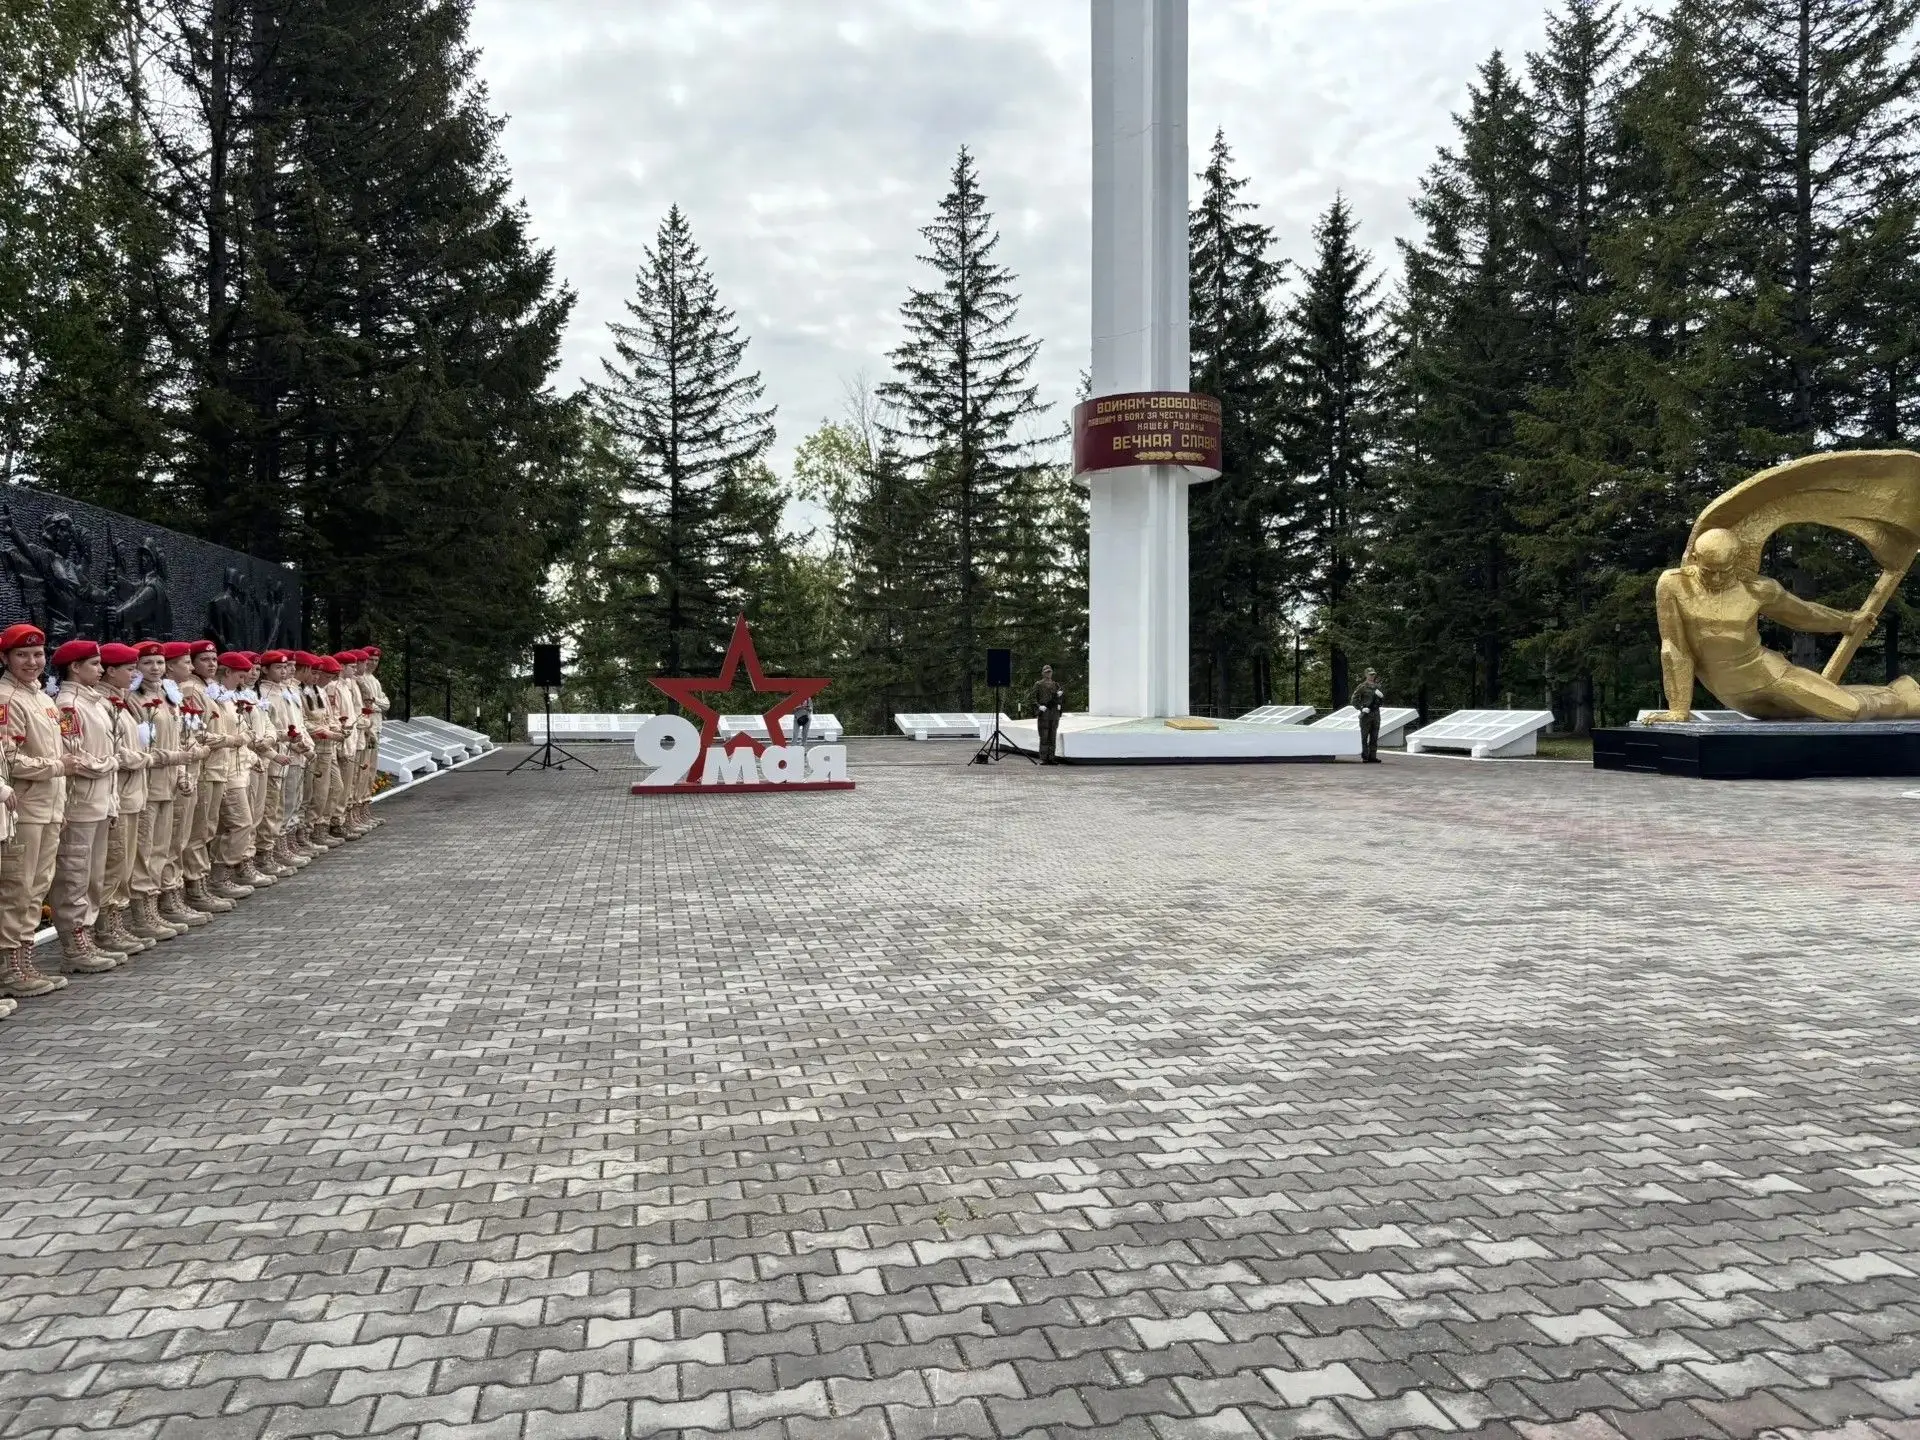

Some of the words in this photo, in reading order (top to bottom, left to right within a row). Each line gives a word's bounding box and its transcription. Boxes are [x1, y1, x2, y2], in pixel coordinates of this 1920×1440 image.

[1124, 412, 1145, 421] БОЯХ
[1146, 411, 1157, 420] ЗА
[1159, 411, 1183, 420] ЧЕСТЬ
[1185, 411, 1190, 420] И
[1137, 420, 1168, 431] НАШЕЙ
[1112, 434, 1172, 450] ВЕЧНАЯ
[634, 714, 701, 786] 9
